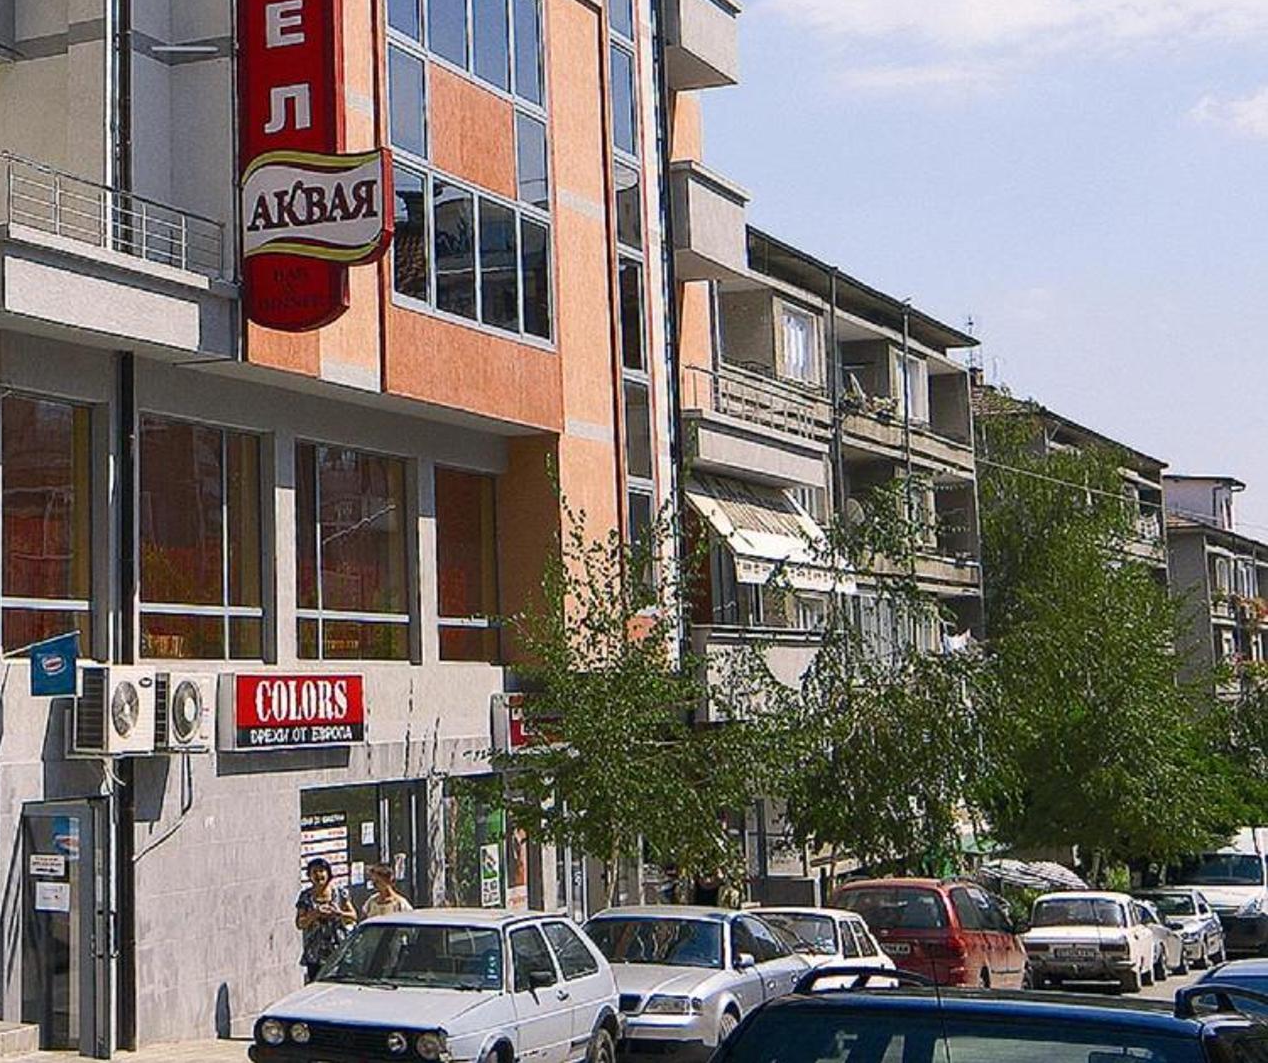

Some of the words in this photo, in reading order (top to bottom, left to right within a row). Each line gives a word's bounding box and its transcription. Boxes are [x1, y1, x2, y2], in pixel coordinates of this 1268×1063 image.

[246, 179, 379, 232] АКВАЯ
[254, 679, 348, 722] COLORS
[292, 725, 308, 742] ОТ
